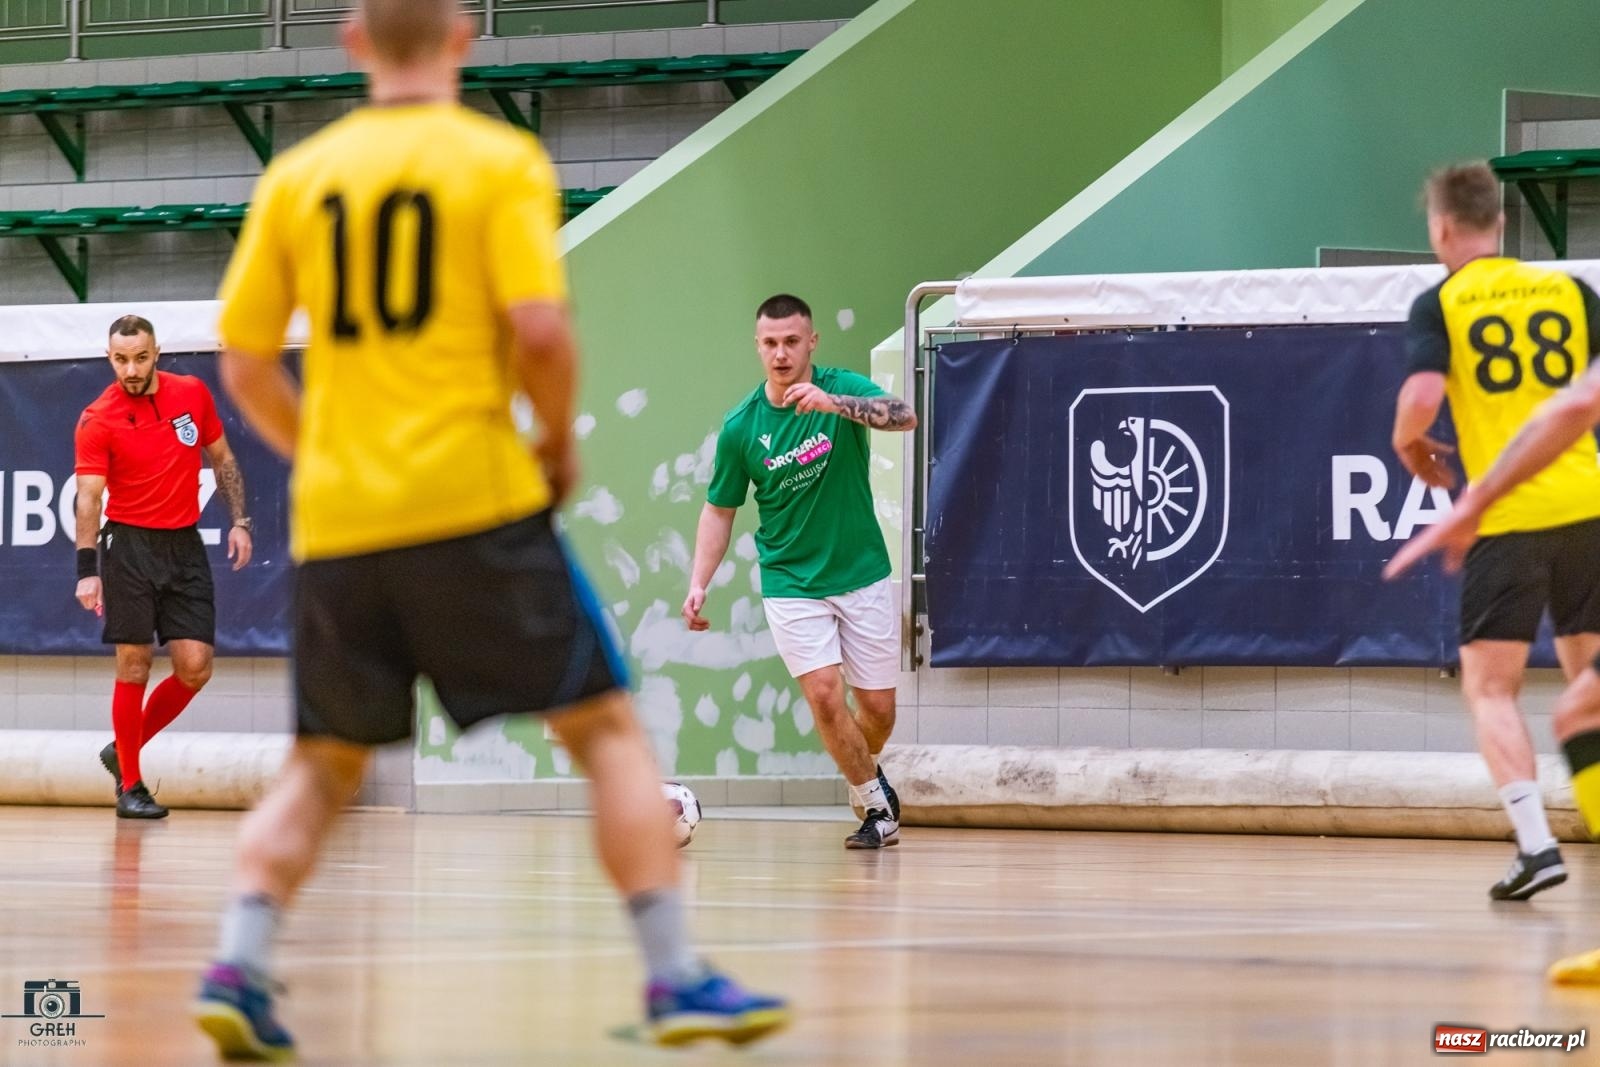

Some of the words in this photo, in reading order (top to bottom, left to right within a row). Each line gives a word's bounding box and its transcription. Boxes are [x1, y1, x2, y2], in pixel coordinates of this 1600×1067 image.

[322, 189, 434, 338] 10
[1469, 310, 1574, 393] 88
[767, 432, 829, 471] DROGERIA
[810, 443, 830, 458] SIECI
